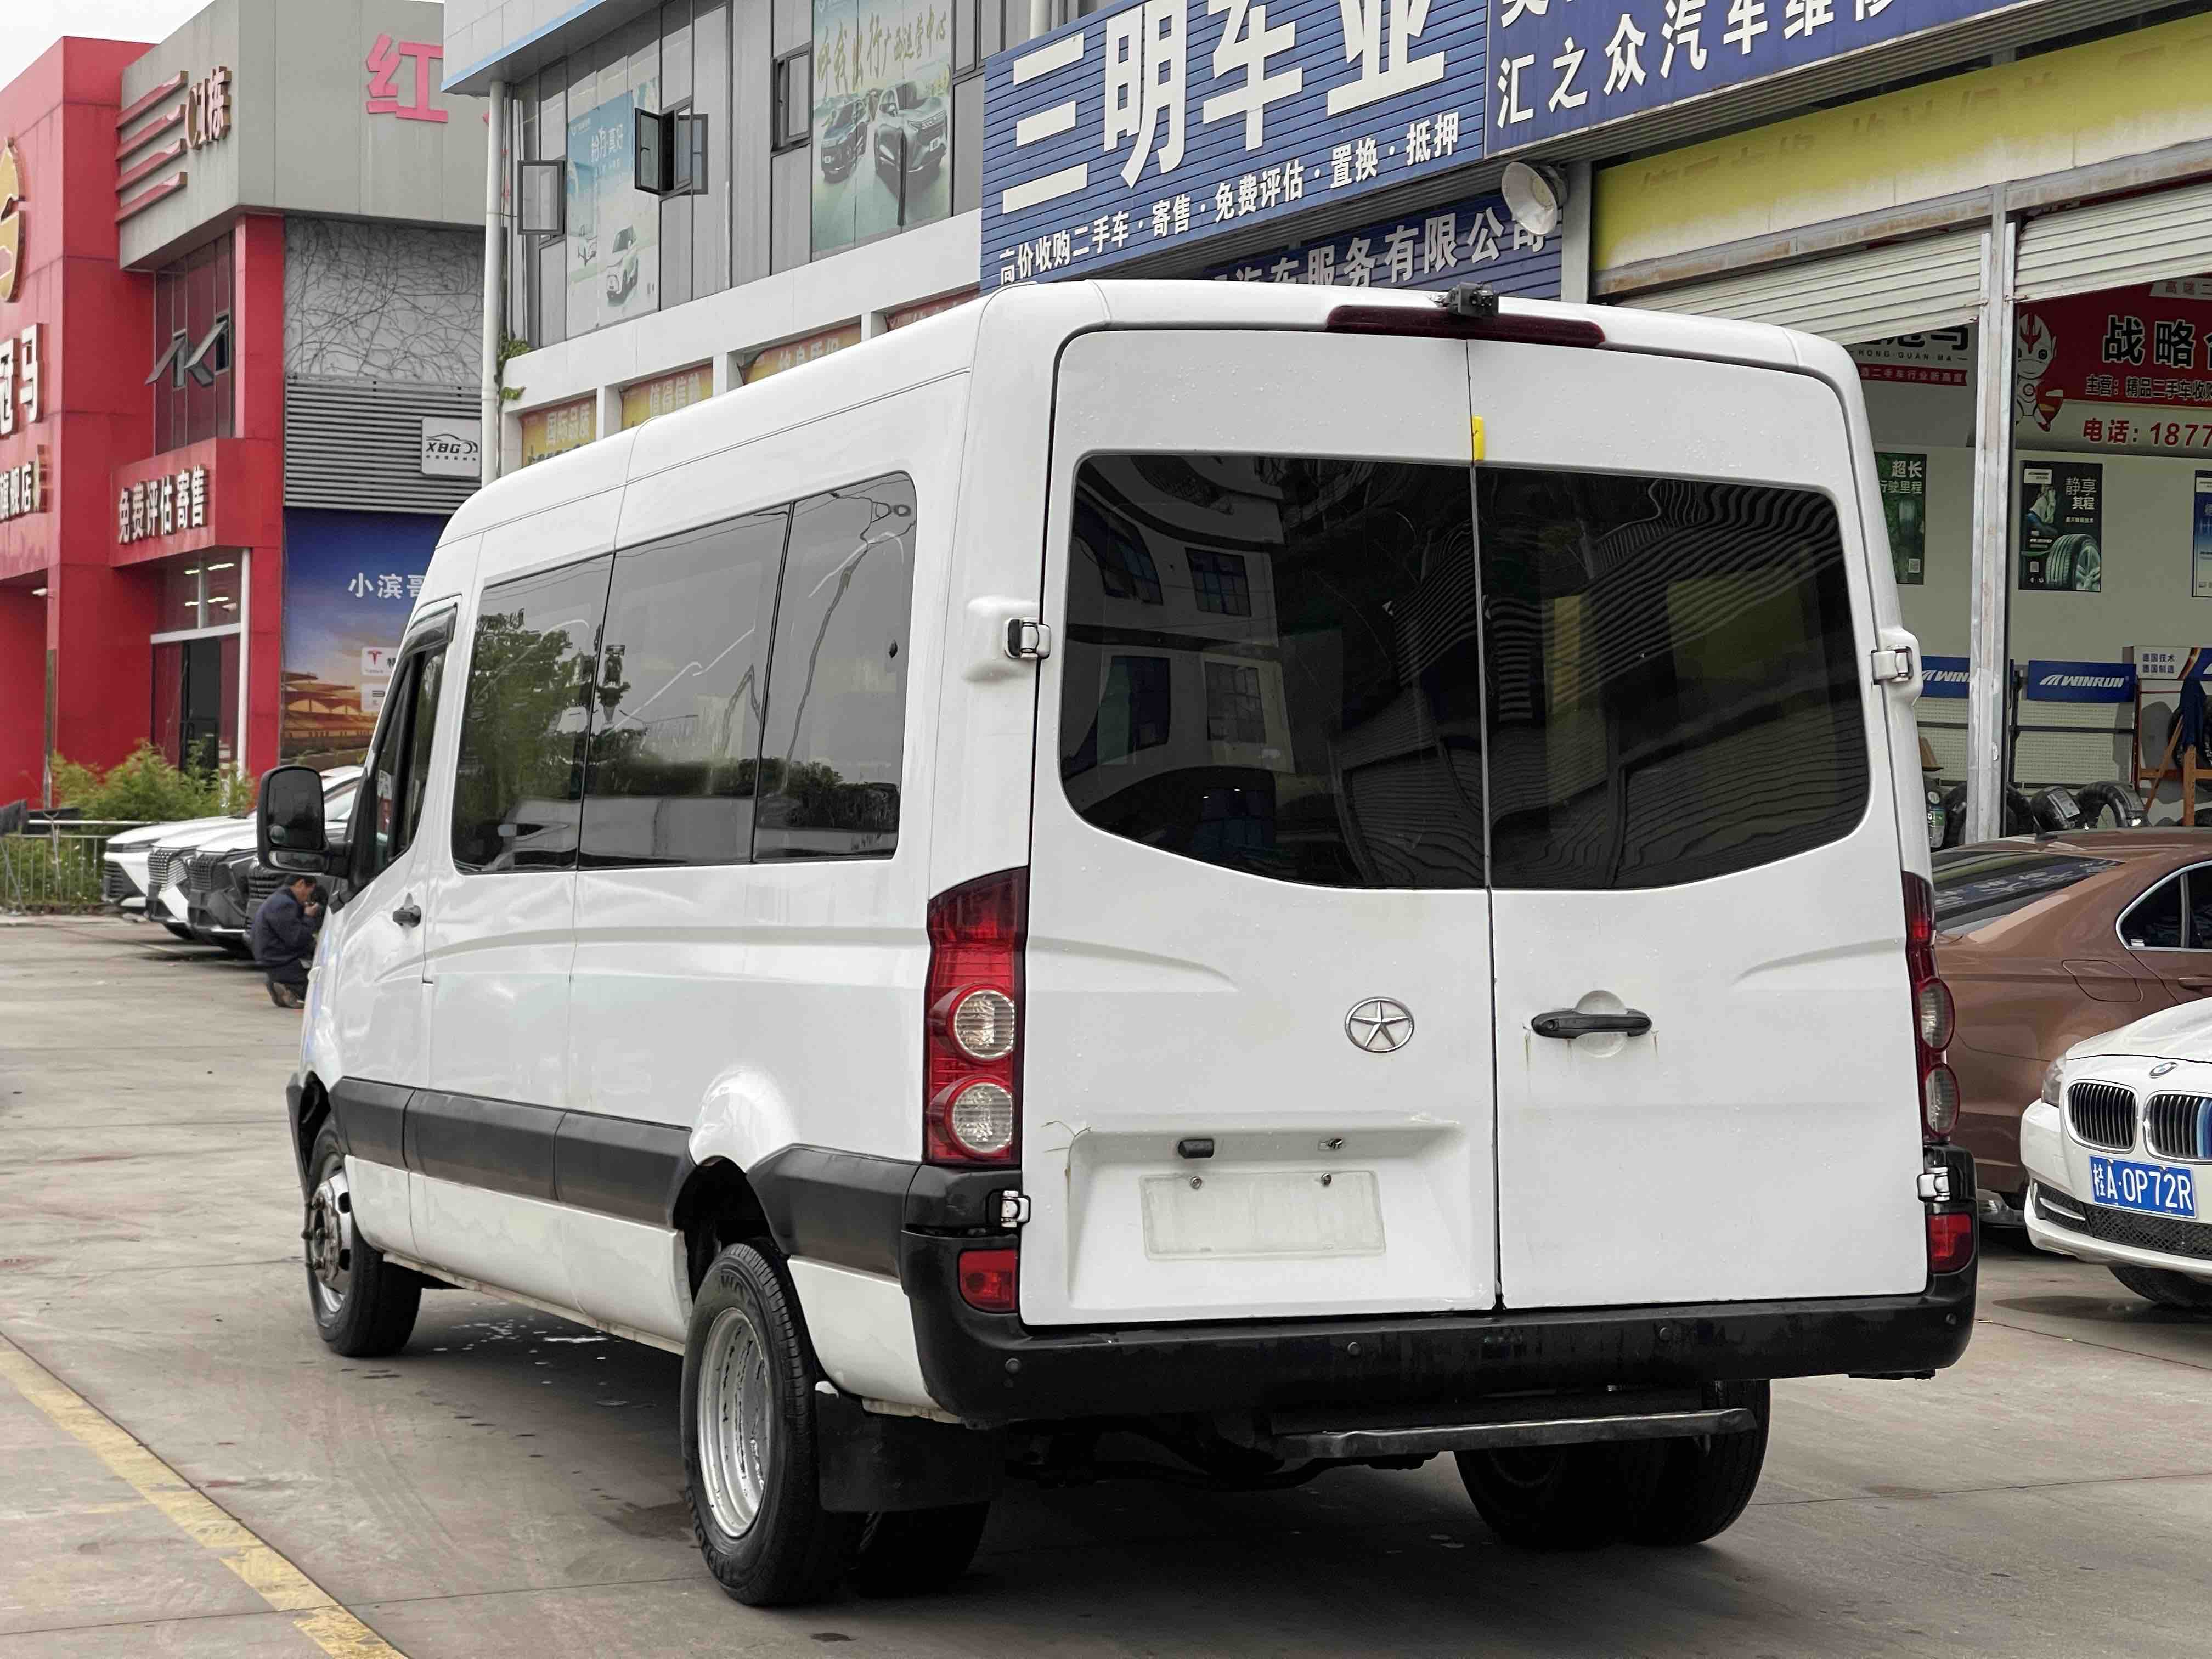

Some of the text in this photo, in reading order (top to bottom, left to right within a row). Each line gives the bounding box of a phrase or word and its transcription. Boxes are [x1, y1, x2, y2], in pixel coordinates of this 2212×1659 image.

[1003, 0, 1445, 188] 三明车业
[2103, 315, 2212, 370] 战略
[1892, 460, 1923, 478] 超长
[1880, 480, 1923, 494] 行驶里程
[2065, 476, 2097, 496] 静享
[119, 465, 207, 544] 免费评估寄售
[1934, 671, 1970, 682] WIN
[2061, 675, 2125, 688] WINRUN
